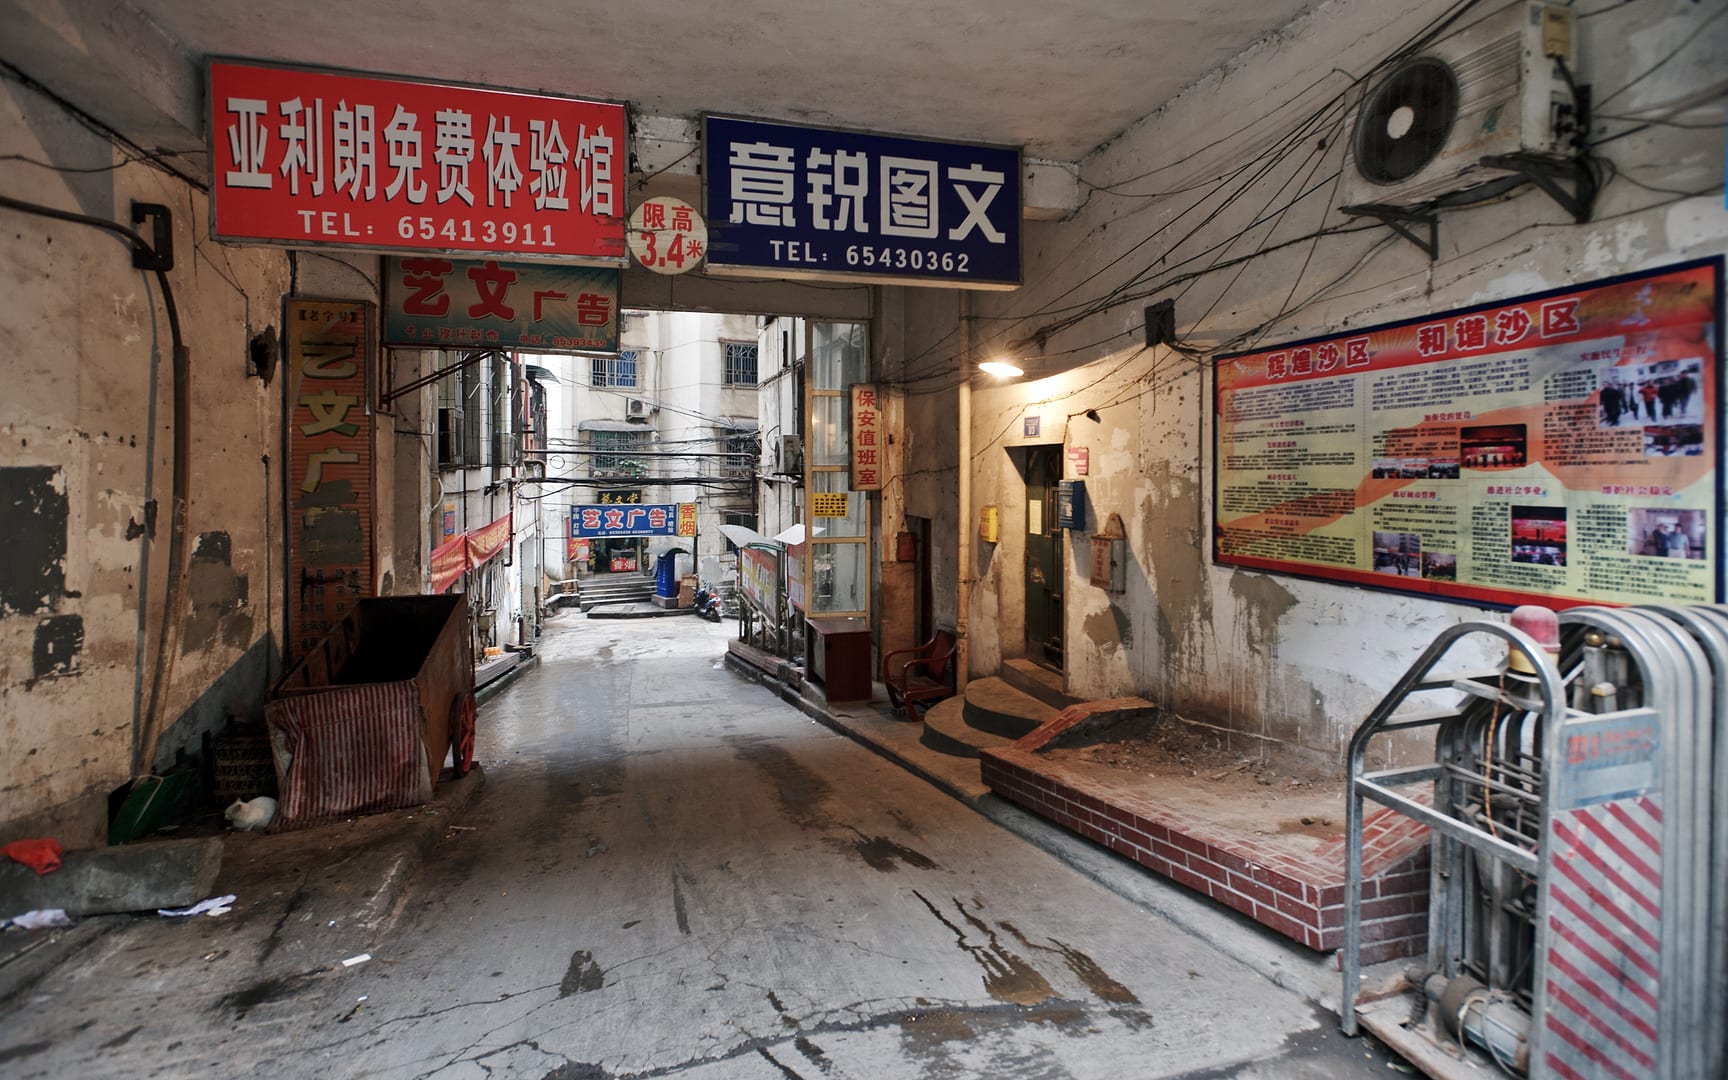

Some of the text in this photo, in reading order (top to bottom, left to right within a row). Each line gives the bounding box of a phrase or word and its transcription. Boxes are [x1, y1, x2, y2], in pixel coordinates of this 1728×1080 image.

[225, 96, 614, 216] 亚利朗免费体验馆
[729, 141, 1006, 245] 意锐图文
[397, 215, 556, 247] 65413911
[642, 203, 694, 232] 限高
[640, 231, 703, 269] 3.4米
[846, 245, 970, 273] 65430362
[401, 257, 613, 327] 艺文广告
[1416, 297, 1581, 357] 和谐沙区
[1266, 336, 1371, 380] 辉煌沙区
[856, 389, 877, 486] 保安值班室
[582, 507, 667, 529] 艺文广告
[680, 504, 696, 536] 香烟
